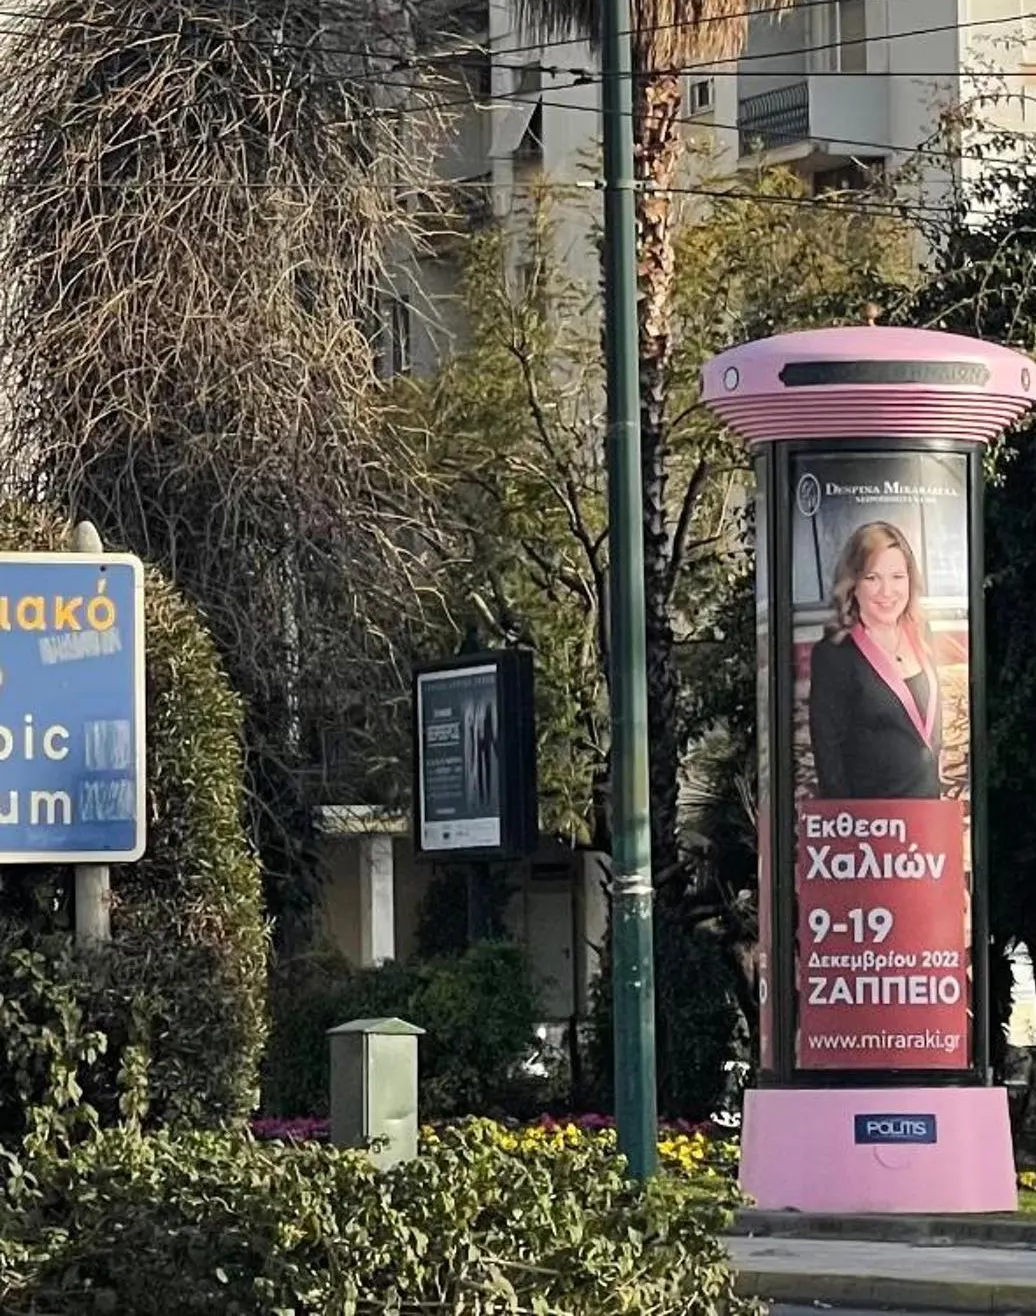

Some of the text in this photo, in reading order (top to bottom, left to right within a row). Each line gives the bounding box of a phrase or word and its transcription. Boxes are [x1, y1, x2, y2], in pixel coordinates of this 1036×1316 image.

[801, 812, 906, 843] Έκθεση
[806, 842, 946, 879] Χαλιών
[808, 907, 893, 943] 9-19
[808, 950, 960, 972] Δεκεμβρίου 2022
[808, 975, 961, 1005] ΖΑΠΠΕΙΟ
[808, 1029, 960, 1053] www.miraraki.gr
